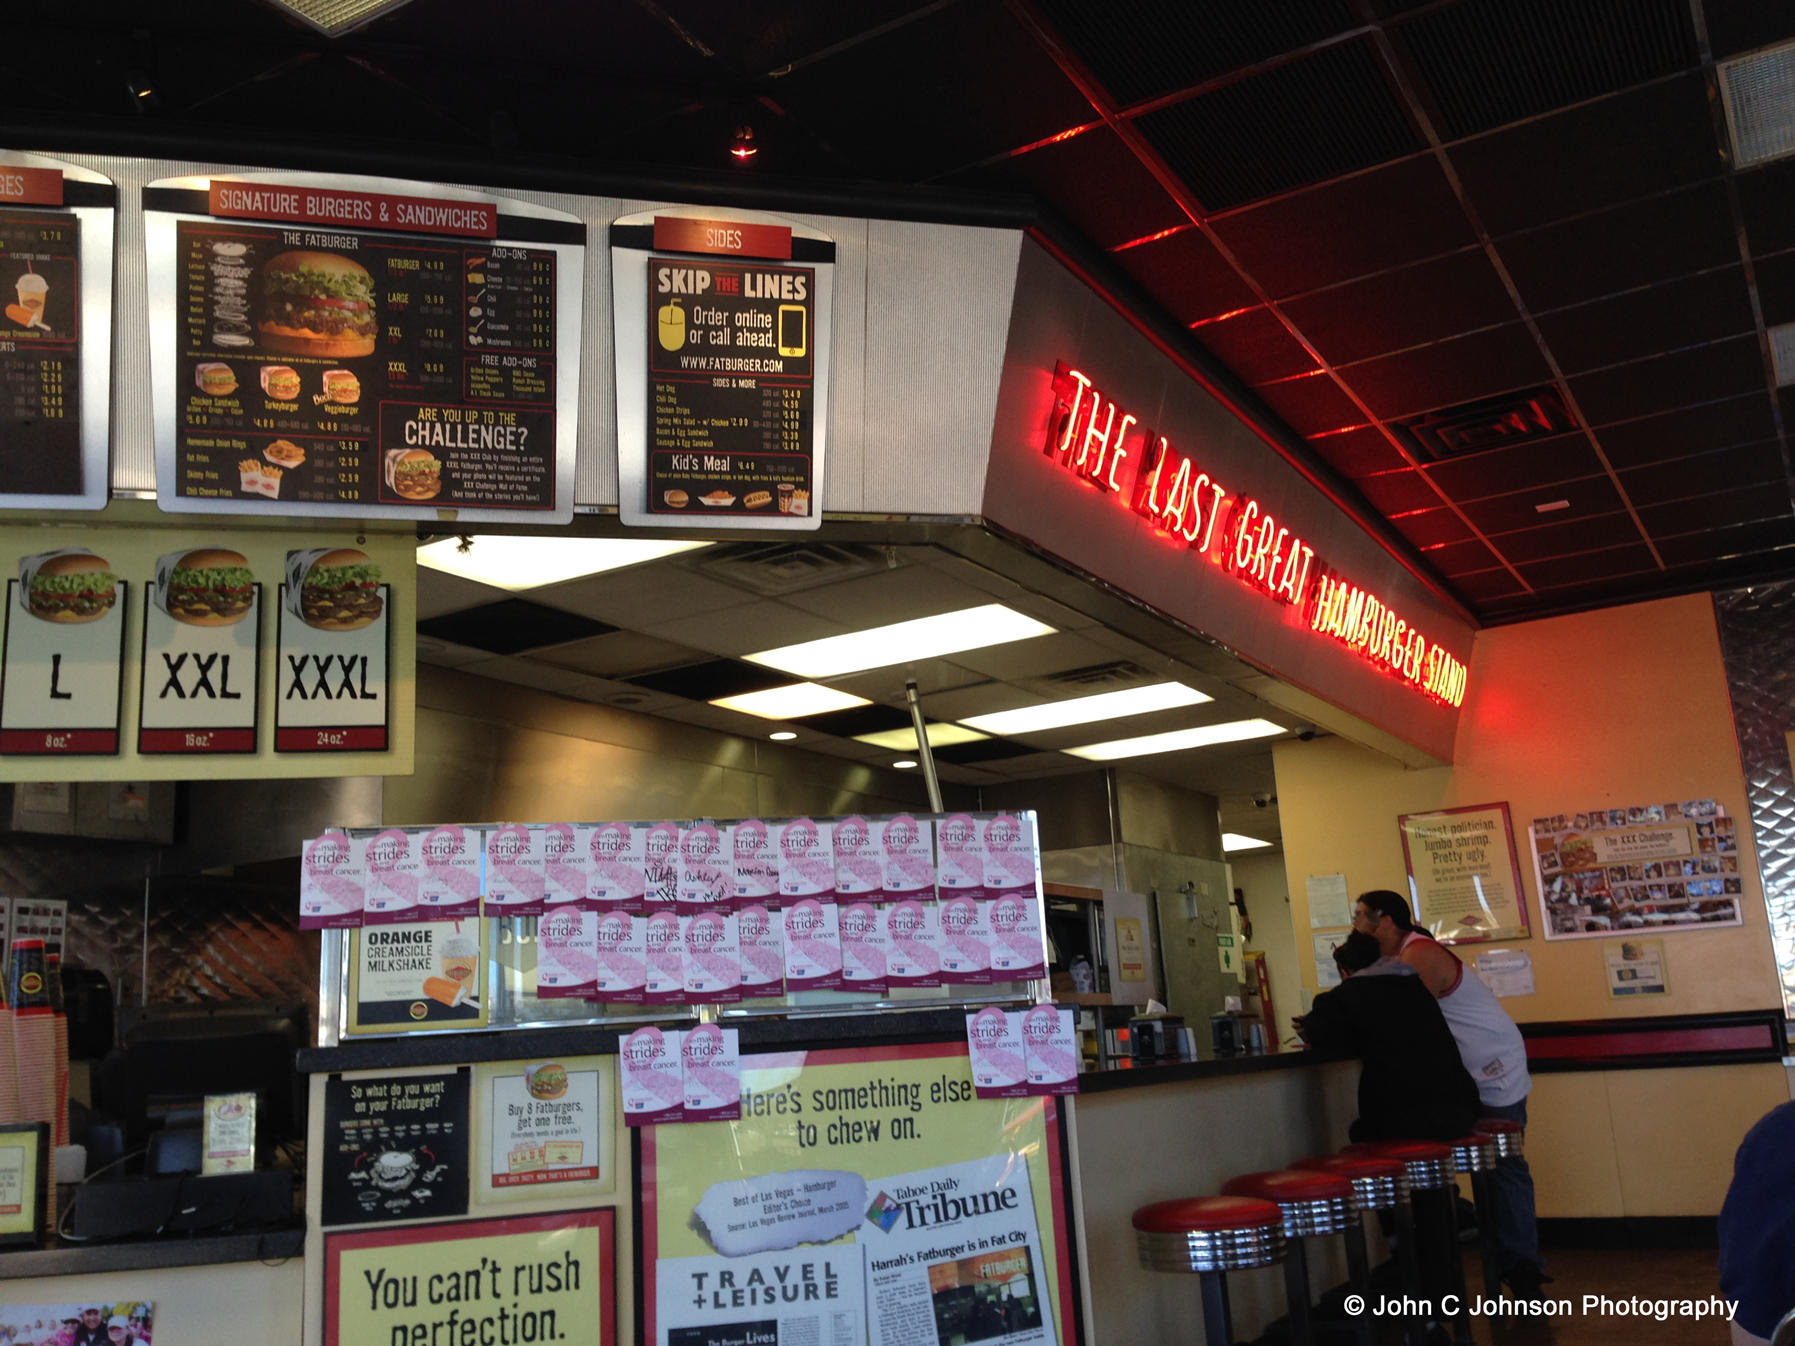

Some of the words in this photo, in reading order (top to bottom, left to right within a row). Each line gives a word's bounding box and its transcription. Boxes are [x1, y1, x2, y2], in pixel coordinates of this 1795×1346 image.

[219, 189, 299, 215] SIGNATURE
[307, 197, 372, 221] BURGERS
[379, 203, 390, 222] &
[396, 204, 488, 230] SANDWICHES
[283, 232, 302, 246] THE
[305, 233, 359, 249] FATBURGER
[706, 228, 742, 249] SIDES
[492, 247, 527, 260] ADD-ONS
[387, 258, 420, 270] FATBURGER
[658, 268, 711, 294] SKIP
[715, 276, 739, 293] THE
[744, 272, 807, 300] LINES
[387, 293, 409, 304] LARGE
[694, 306, 729, 325] Order
[735, 309, 772, 328] online
[388, 326, 402, 338] XXL
[689, 332, 704, 344] or
[710, 328, 730, 345] call
[736, 330, 776, 348] ahead.
[388, 361, 407, 373] XXXL
[481, 354, 499, 366] FREE
[502, 356, 537, 368] ADD-ONS
[680, 356, 783, 373] WWW.FATBURGER.COM
[712, 378, 730, 388] SIDES
[731, 379, 736, 388] &
[738, 379, 756, 389] MORE
[418, 407, 438, 421] ARE
[442, 408, 461, 422] YOU
[465, 410, 478, 423] UP
[483, 411, 495, 425] TO
[498, 412, 517, 426] THE
[404, 420, 528, 451] CHALLENGE?
[672, 454, 699, 470] Kid's
[704, 455, 730, 471] Meal
[1060, 370, 1136, 492] THE
[1148, 437, 1225, 553] LAST
[1236, 500, 1314, 604] GREAT
[1311, 574, 1425, 682] HAMBURGER
[1423, 643, 1467, 708] STAND
[50, 654, 72, 700] L
[159, 652, 241, 700] XXL
[286, 653, 377, 700] XXXL
[780, 836, 819, 848] strides
[832, 835, 870, 846] strides
[882, 834, 920, 844] strides
[940, 831, 976, 842] strides
[984, 831, 1021, 842] strides
[1424, 838, 1452, 852] Jumbo
[1456, 834, 1492, 848] shrimp.
[422, 843, 466, 855] strides
[489, 842, 531, 854] strides
[590, 839, 632, 851] strides
[680, 842, 720, 854] strides
[305, 853, 350, 864] strides
[366, 848, 410, 861] strides
[1432, 850, 1462, 864] Pretty
[785, 918, 825, 930] strides
[888, 919, 925, 929] strides
[941, 914, 978, 925] strides
[990, 911, 1028, 922] strides
[541, 925, 583, 937] strides
[839, 921, 877, 932] strides
[368, 930, 432, 946] ORANGE
[685, 931, 725, 943] strides
[367, 944, 433, 959] CREAMSICLE
[368, 957, 432, 973] MILKSHAKE
[970, 1025, 1009, 1039] strides
[1023, 1022, 1061, 1035] strides
[623, 1046, 666, 1060] strides
[682, 1043, 724, 1057] strides
[351, 1085, 362, 1099] So
[365, 1084, 388, 1098] what
[390, 1083, 401, 1096] do
[404, 1084, 420, 1100] you
[422, 1080, 445, 1093] want
[740, 1086, 802, 1119] Here's
[812, 1077, 921, 1114] something
[930, 1074, 972, 1103] else
[354, 1102, 366, 1113] on
[369, 1100, 389, 1116] your
[391, 1094, 440, 1112] Fatburger?
[508, 1104, 524, 1118] Buy
[527, 1102, 533, 1115] 8
[536, 1101, 583, 1115] Fatburgers,
[517, 1116, 532, 1131] get
[535, 1116, 551, 1127] one
[554, 1113, 575, 1126] free.
[797, 1118, 818, 1148] to
[828, 1113, 881, 1145] chew
[891, 1115, 921, 1139] on.
[733, 1196, 749, 1207] Best
[751, 1194, 758, 1204] of
[760, 1191, 773, 1202] Las
[774, 1188, 794, 1200] Vegas
[803, 1180, 837, 1193] Hamburger
[893, 1183, 929, 1200] Tahoe
[930, 1177, 961, 1193] Daily
[763, 1202, 788, 1215] Editor's
[790, 1198, 811, 1209] Choice
[899, 1186, 1019, 1230] Tribune
[871, 1250, 915, 1272] Harrah's
[916, 1243, 966, 1262] Fatburger
[967, 1240, 976, 1252] is
[978, 1238, 989, 1250] in
[990, 1233, 1007, 1247] Fat
[1008, 1230, 1027, 1244] City
[364, 1268, 418, 1310] You
[428, 1257, 502, 1304] can't
[514, 1250, 580, 1296] rush
[691, 1262, 838, 1291] TRAVEL
[692, 1283, 839, 1310] +LEISURE
[392, 1303, 565, 1346] perfection.
[746, 1331, 776, 1345] Lives
